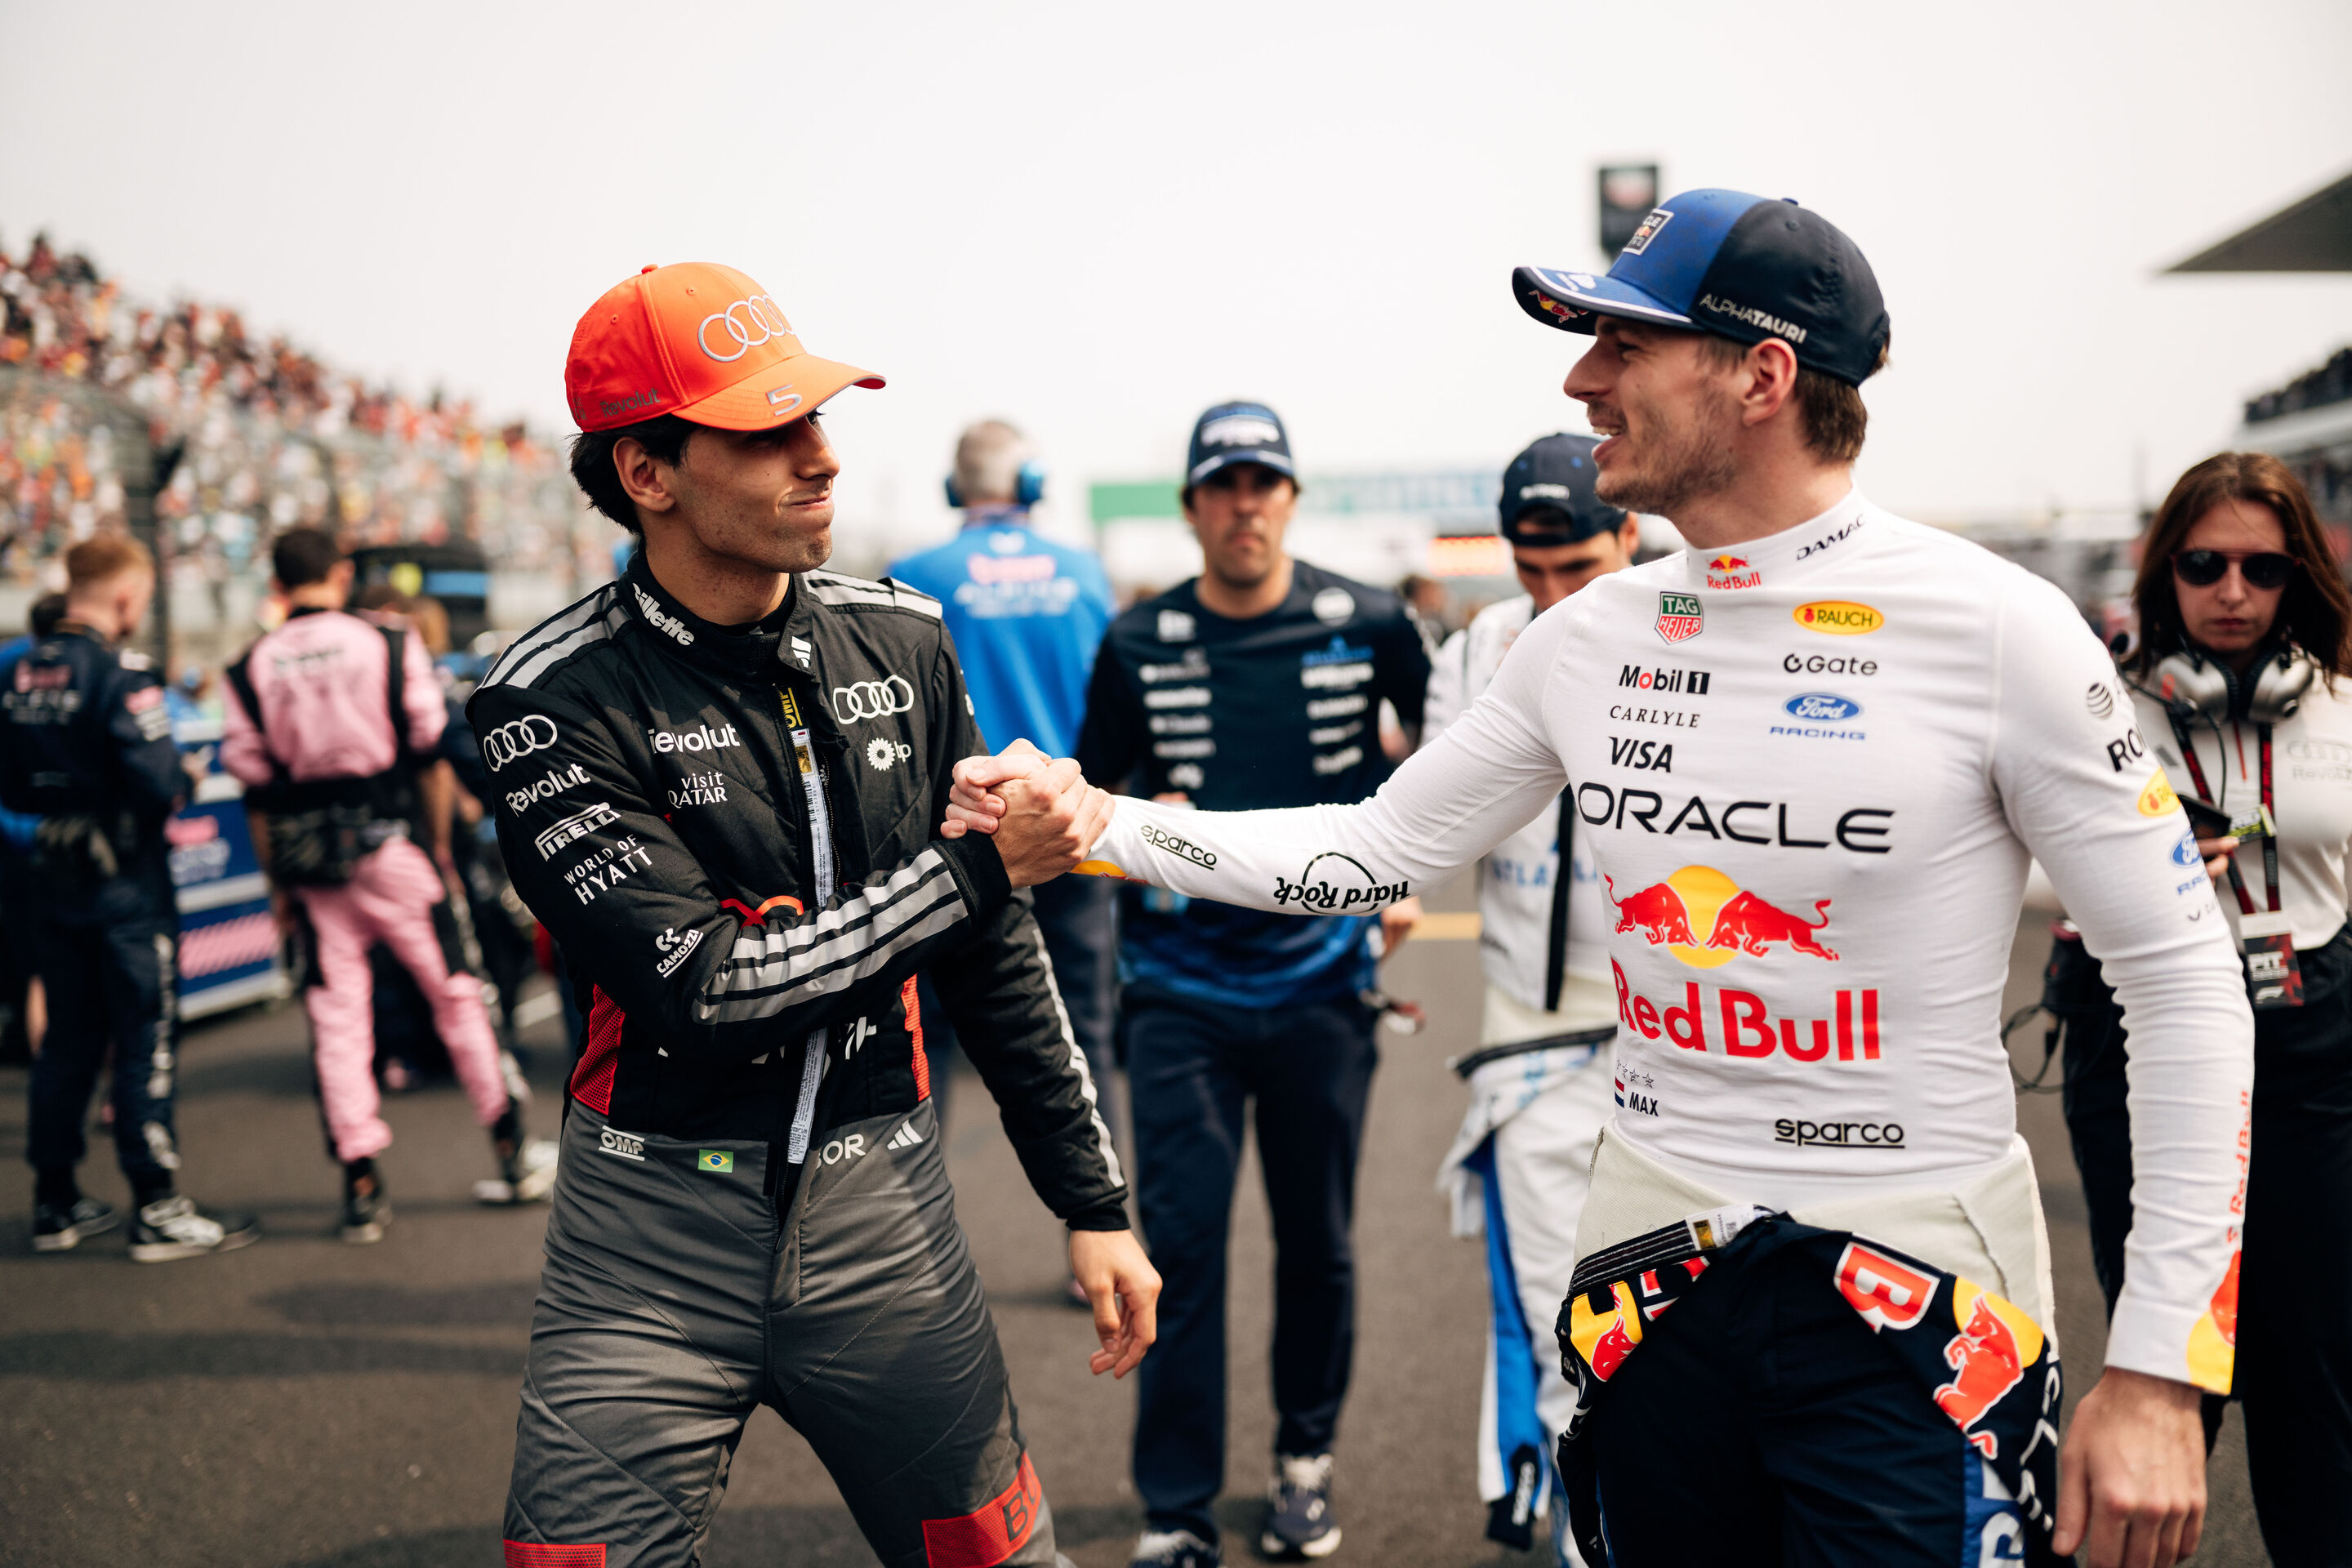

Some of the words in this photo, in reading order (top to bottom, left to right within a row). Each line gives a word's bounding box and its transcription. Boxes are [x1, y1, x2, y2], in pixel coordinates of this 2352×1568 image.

[1699, 293, 1807, 344] ALPHATAURI
[599, 387, 661, 419] Revolut
[766, 384, 803, 416] 5
[1796, 514, 1865, 561] DAMAC
[1706, 574, 1731, 590] Red
[1732, 571, 1762, 589] Bull
[1664, 597, 1699, 614] TAG
[1817, 608, 1873, 627] RAUCH
[1659, 617, 1700, 640] HEUER
[1619, 664, 1683, 693] Mobil
[1610, 705, 1701, 728] CARLYLE
[1795, 694, 1848, 719] Ford
[1770, 725, 1866, 740] RACING
[1608, 736, 1673, 773] VISA
[506, 763, 591, 817] Revolut
[680, 771, 724, 790] visit
[667, 786, 728, 809] QATAR
[1578, 782, 1896, 854] ORACLE
[564, 847, 615, 885] WORLD
[617, 834, 637, 851] OF
[1140, 825, 1218, 867] sparco
[574, 845, 653, 906] HYATT
[1273, 876, 1339, 908] Rock
[1340, 880, 1410, 909] Hard
[656, 929, 700, 973] CAMOZZI
[1610, 956, 1708, 1053] Red
[1719, 988, 1881, 1062] Bull
[1628, 1091, 1659, 1117] MAX
[600, 1131, 644, 1156] OMP
[1775, 1117, 1904, 1147] sparco
